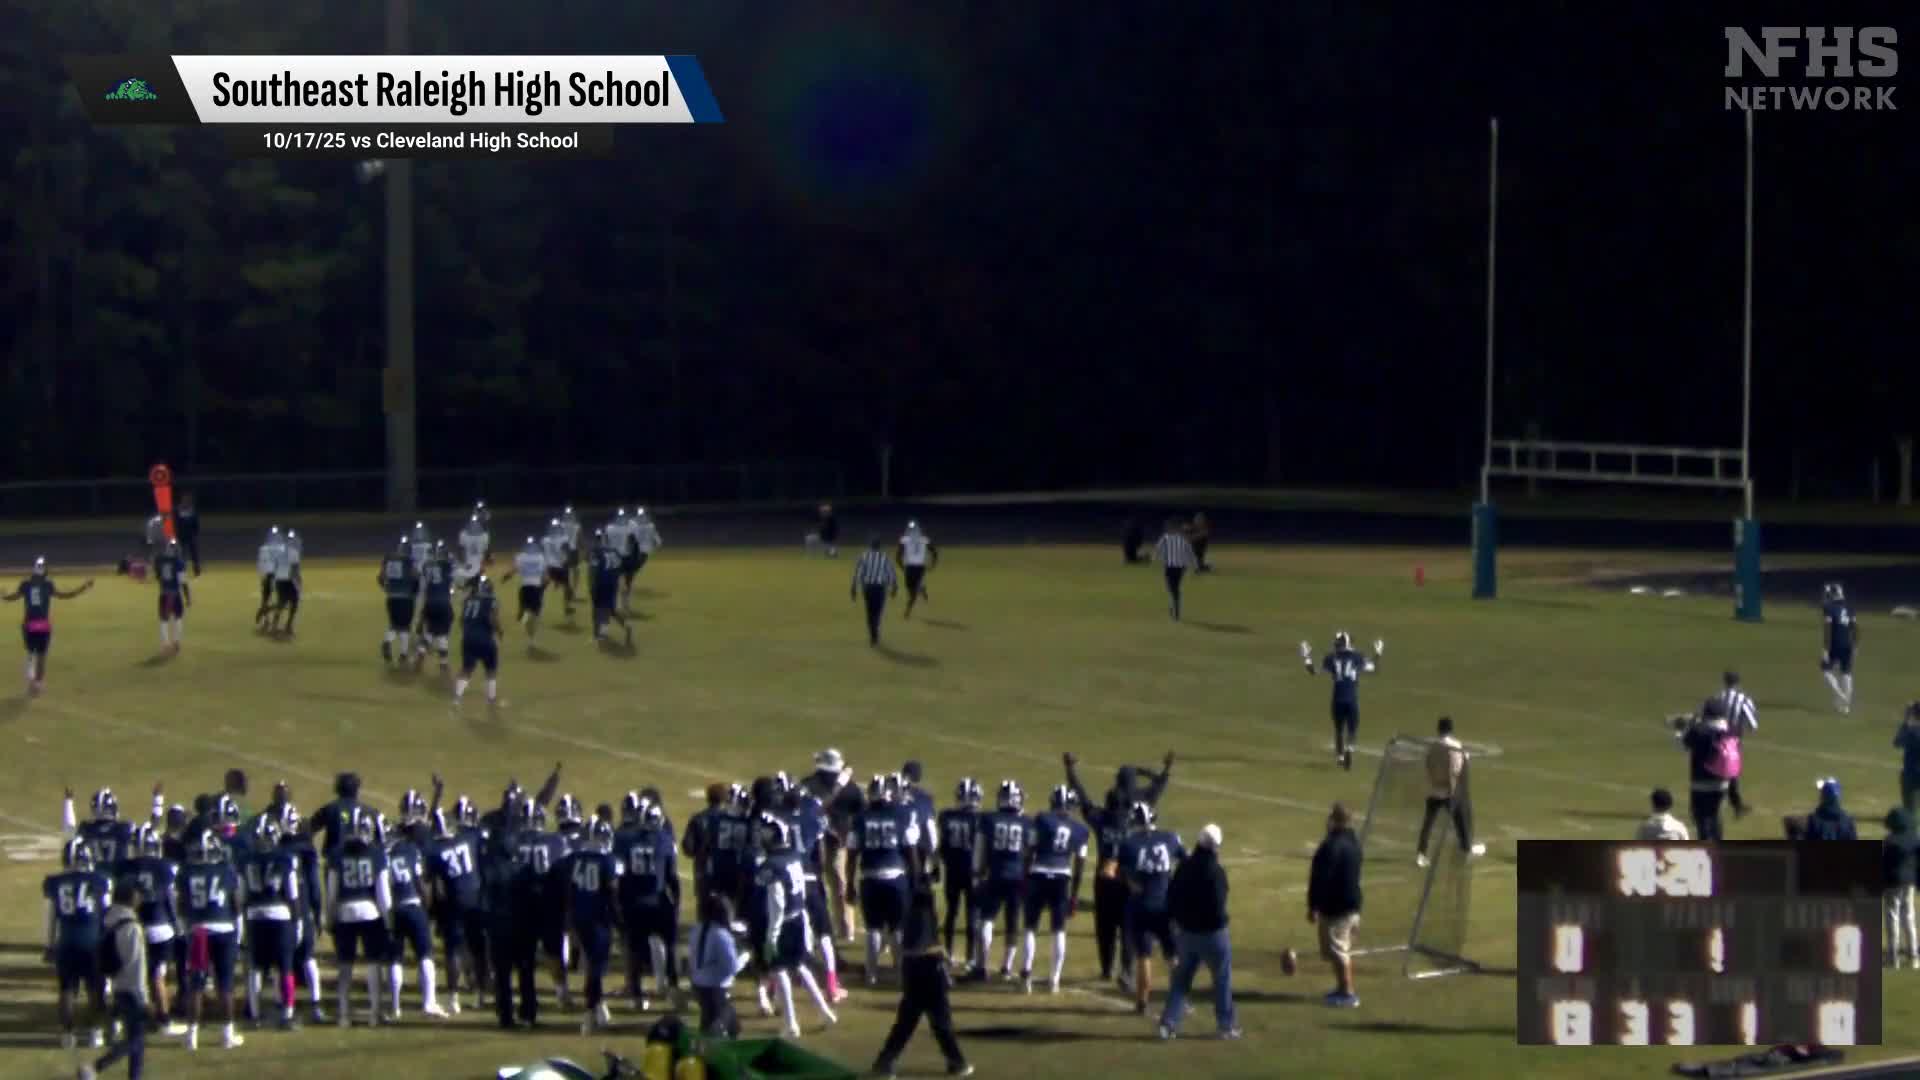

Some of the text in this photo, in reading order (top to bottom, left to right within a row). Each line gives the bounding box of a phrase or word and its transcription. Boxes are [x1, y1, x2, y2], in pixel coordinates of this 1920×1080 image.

[1335, 660, 1357, 681] 14
[441, 843, 472, 878] 37
[573, 858, 599, 892] 40
[57, 882, 95, 916] 64
[189, 876, 226, 909] 54
